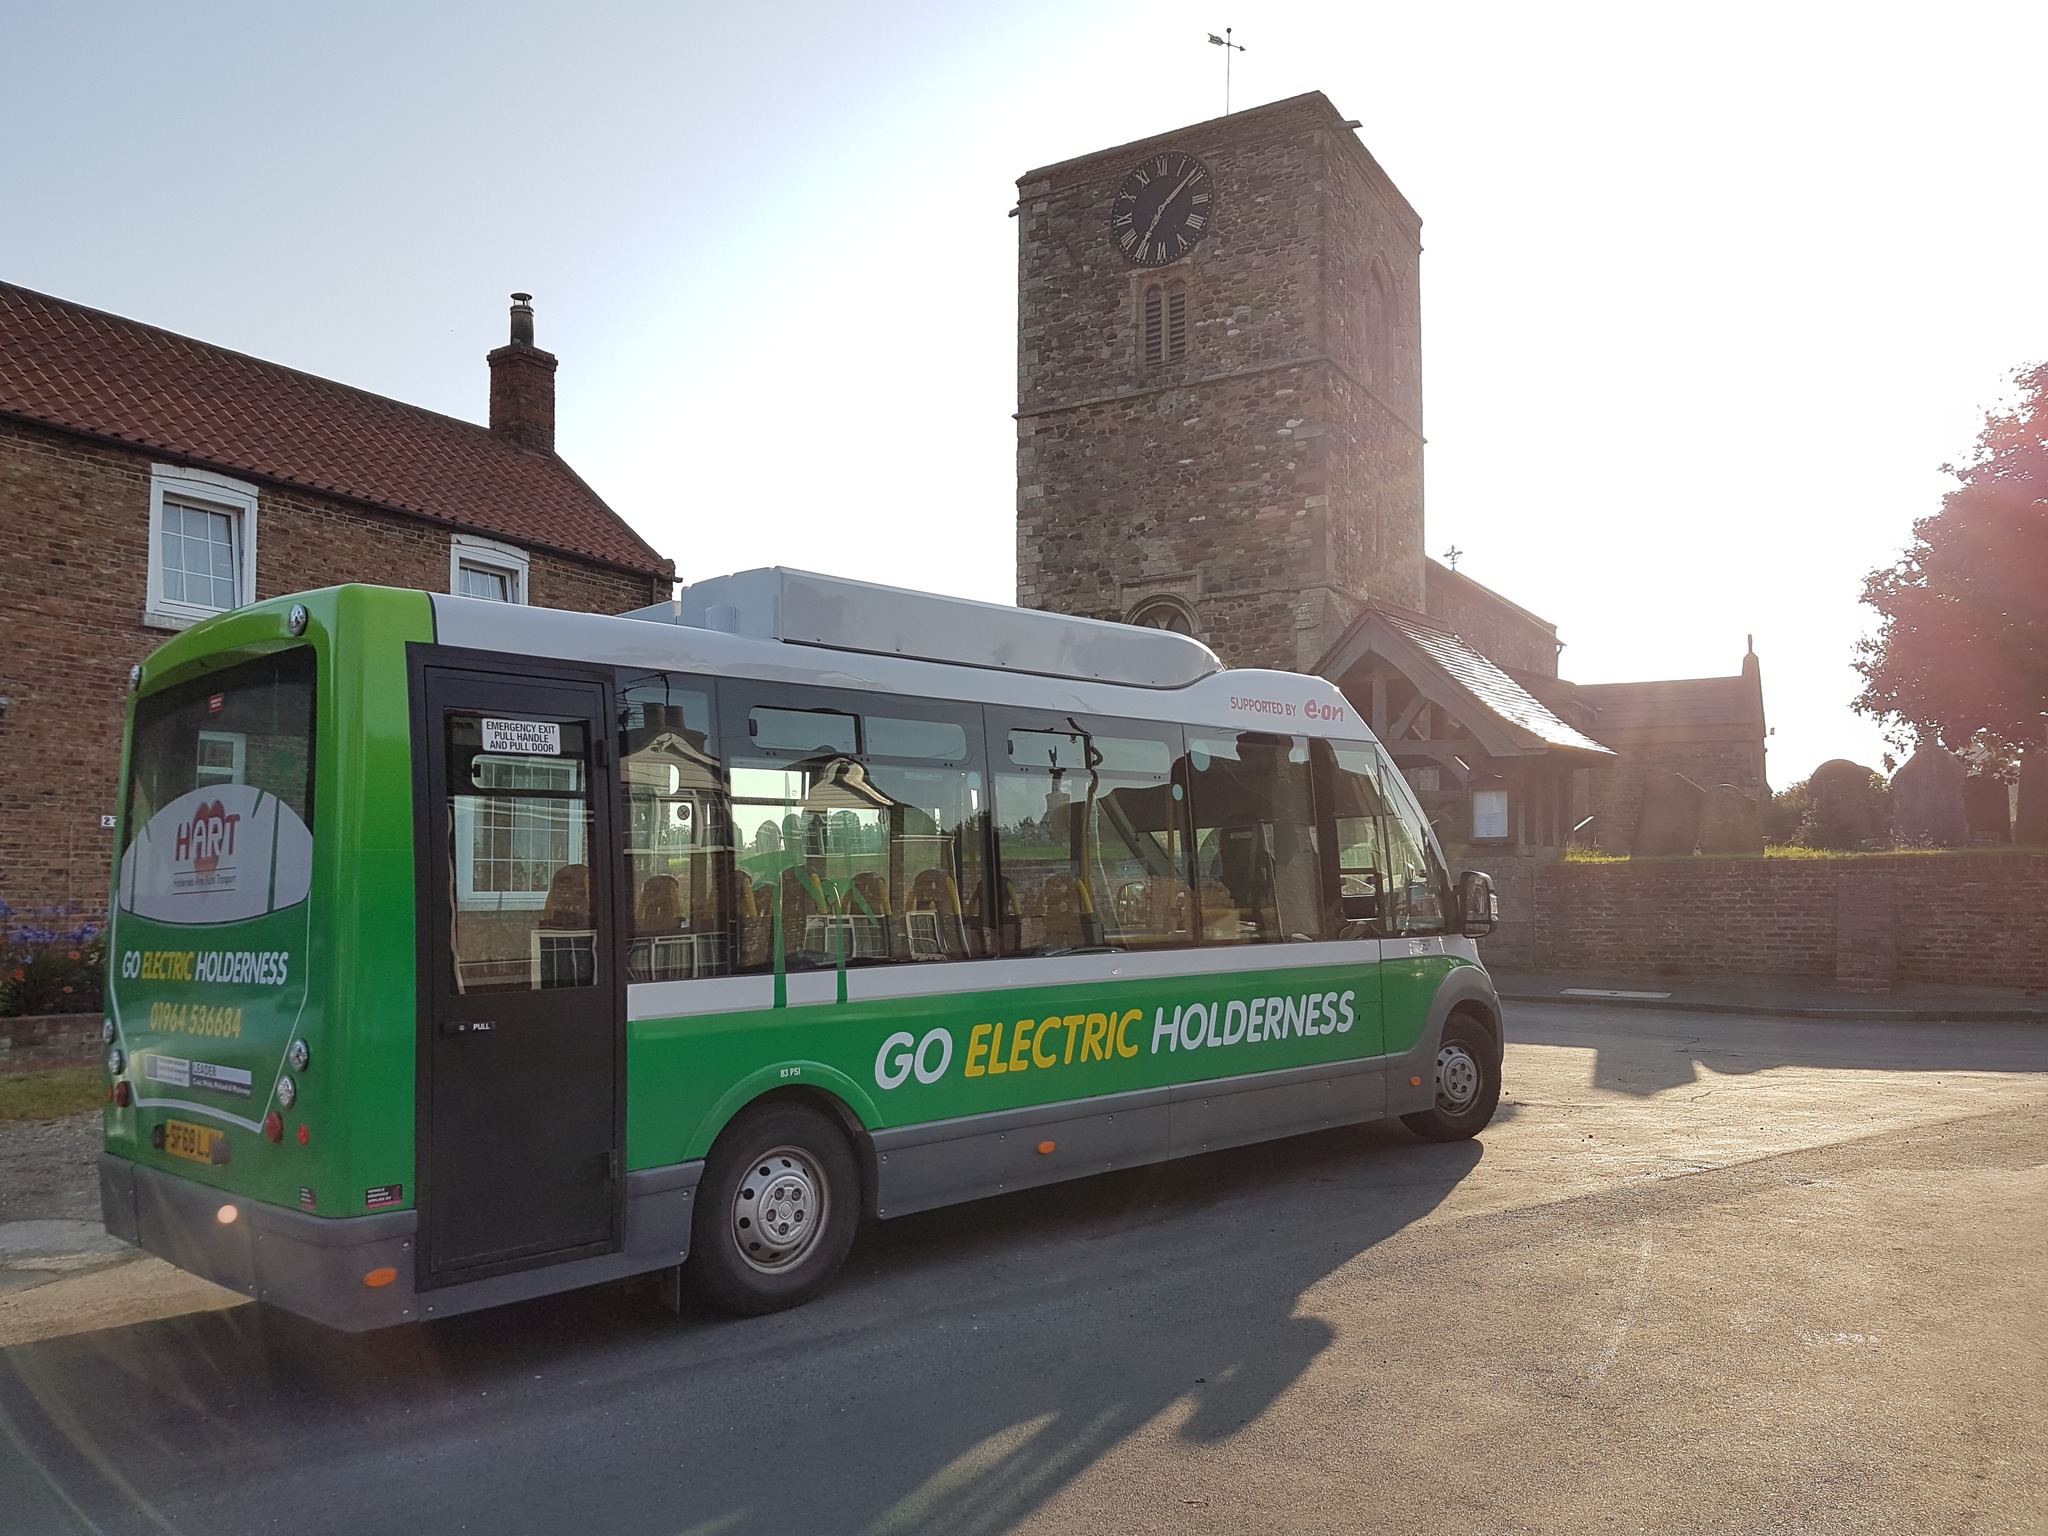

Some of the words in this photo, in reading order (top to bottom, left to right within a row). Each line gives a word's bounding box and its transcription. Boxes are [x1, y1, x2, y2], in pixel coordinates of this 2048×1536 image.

[1230, 696, 1283, 715] SUPPORTED
[1285, 704, 1297, 717] BY
[486, 721, 537, 733] EMERGENCY
[538, 724, 556, 735] EXIT
[494, 731, 514, 741] PULL
[516, 733, 549, 743] HANDLE
[489, 741, 507, 750] AND
[509, 742, 530, 751] PULL
[531, 743, 554, 753] DOOR
[175, 813, 241, 861] HART
[123, 951, 141, 978] GO
[141, 950, 195, 981] ELECTRIC
[195, 951, 289, 985] HOLDERNESS
[150, 1001, 186, 1031] 01964
[188, 1004, 243, 1039] 536684
[874, 1027, 954, 1090] GO
[964, 1008, 1143, 1078] ELECTRIC
[1151, 990, 1355, 1055] HOLDERNESS
[193, 1063, 217, 1077] LEADER
[780, 1069, 789, 1078] 83
[790, 1067, 801, 1077] PSI
